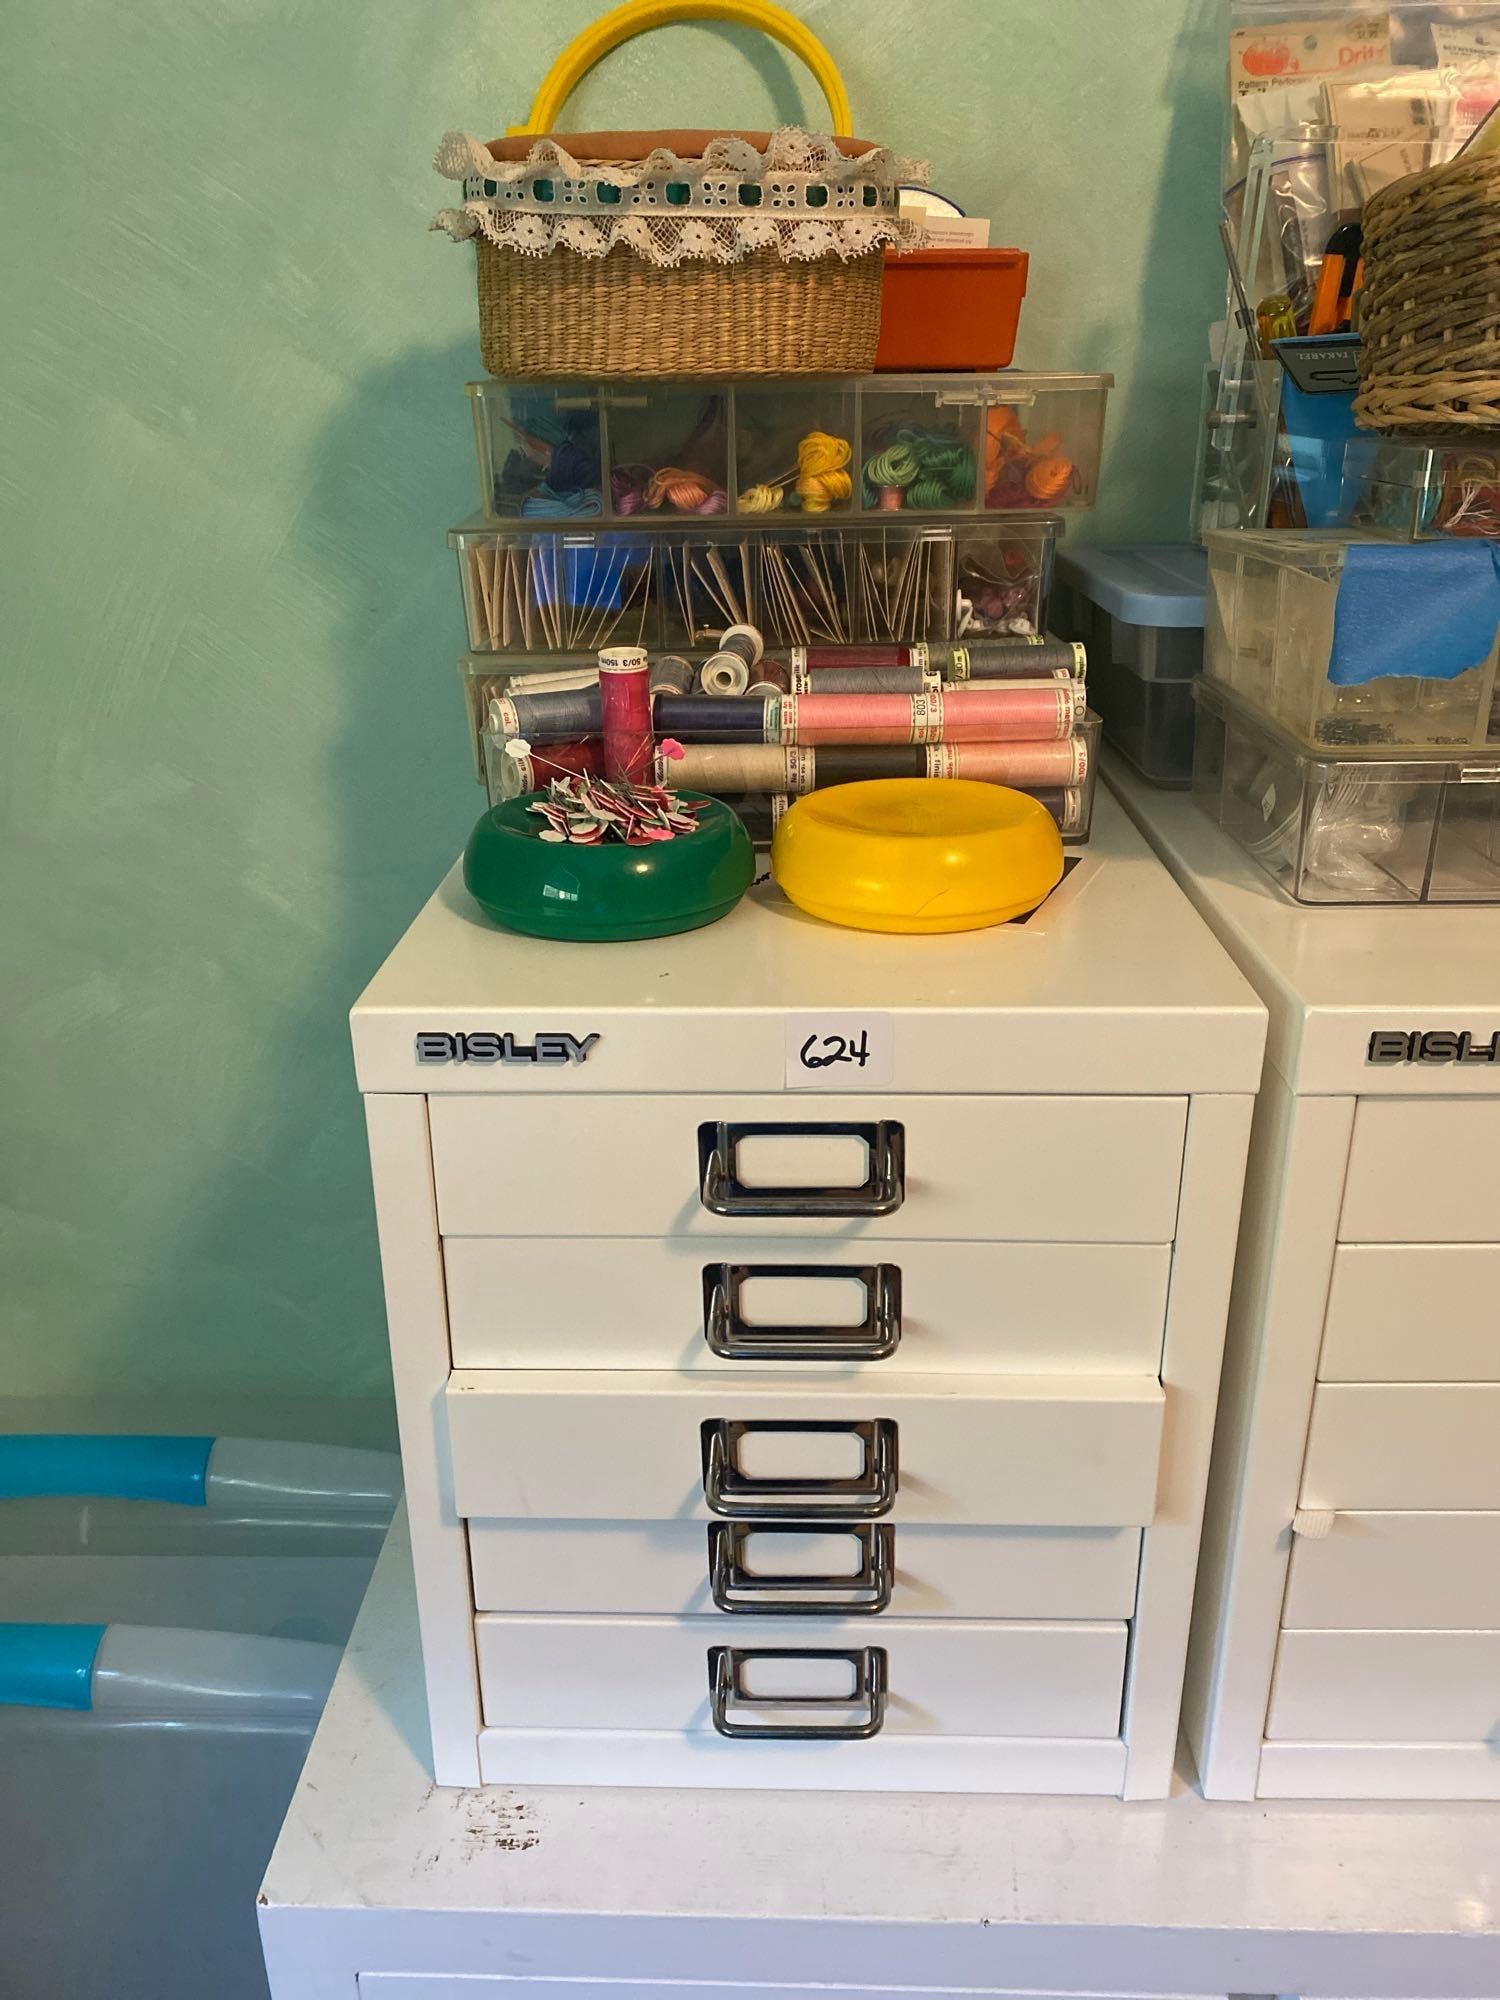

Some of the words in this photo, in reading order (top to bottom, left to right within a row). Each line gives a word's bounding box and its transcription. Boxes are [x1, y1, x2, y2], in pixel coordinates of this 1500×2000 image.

[1237, 78, 1269, 89] Pattern
[916, 699, 926, 716] 803
[1078, 751, 1087, 776] 100/3
[790, 773, 797, 783] Ne
[416, 1032, 600, 1063] BISLEY
[800, 1030, 870, 1068] 624
